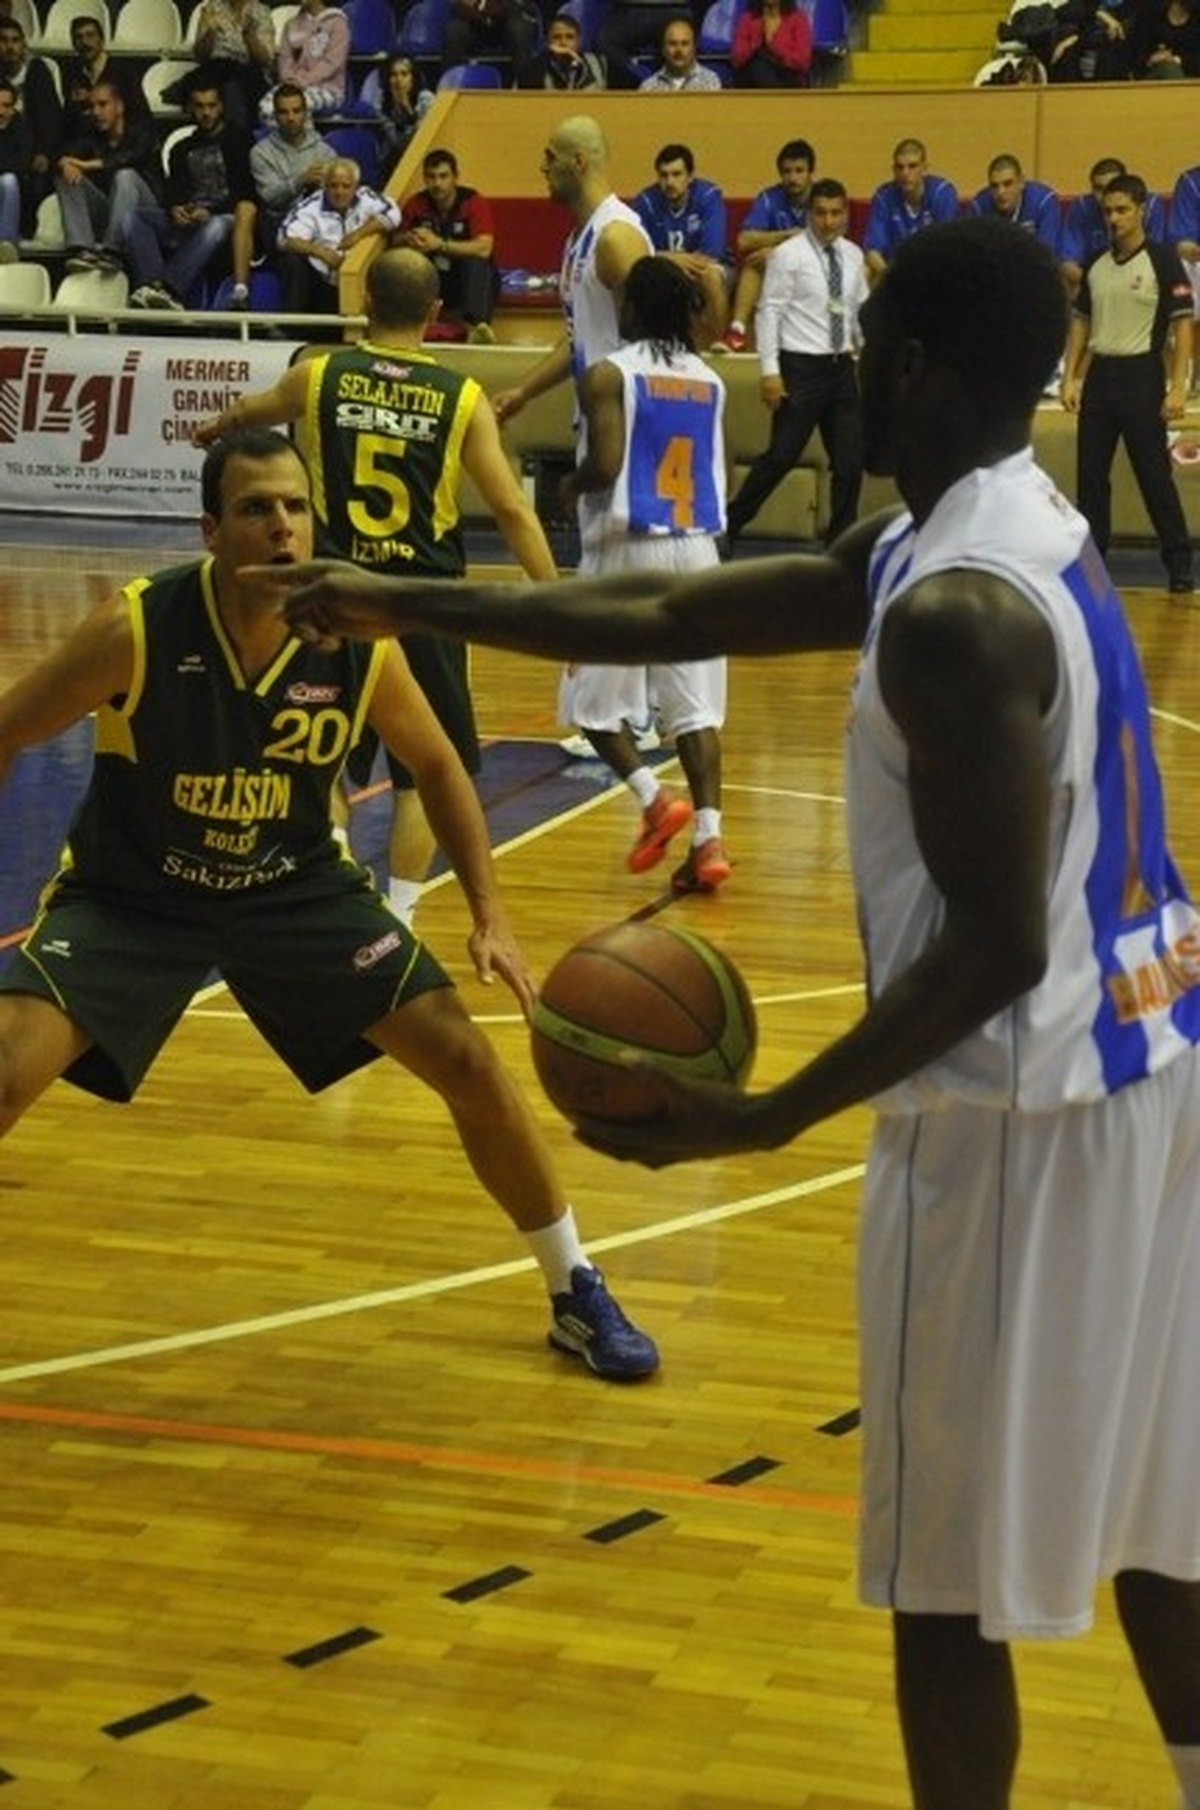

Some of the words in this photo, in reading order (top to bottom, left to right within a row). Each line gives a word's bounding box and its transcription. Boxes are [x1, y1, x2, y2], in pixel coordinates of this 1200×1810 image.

[166, 358, 250, 382] MERMER
[173, 387, 243, 412] GRANİT
[347, 433, 410, 537] 5
[656, 435, 694, 529] 4
[263, 708, 350, 766] 20
[173, 768, 292, 826] GELİŞİM
